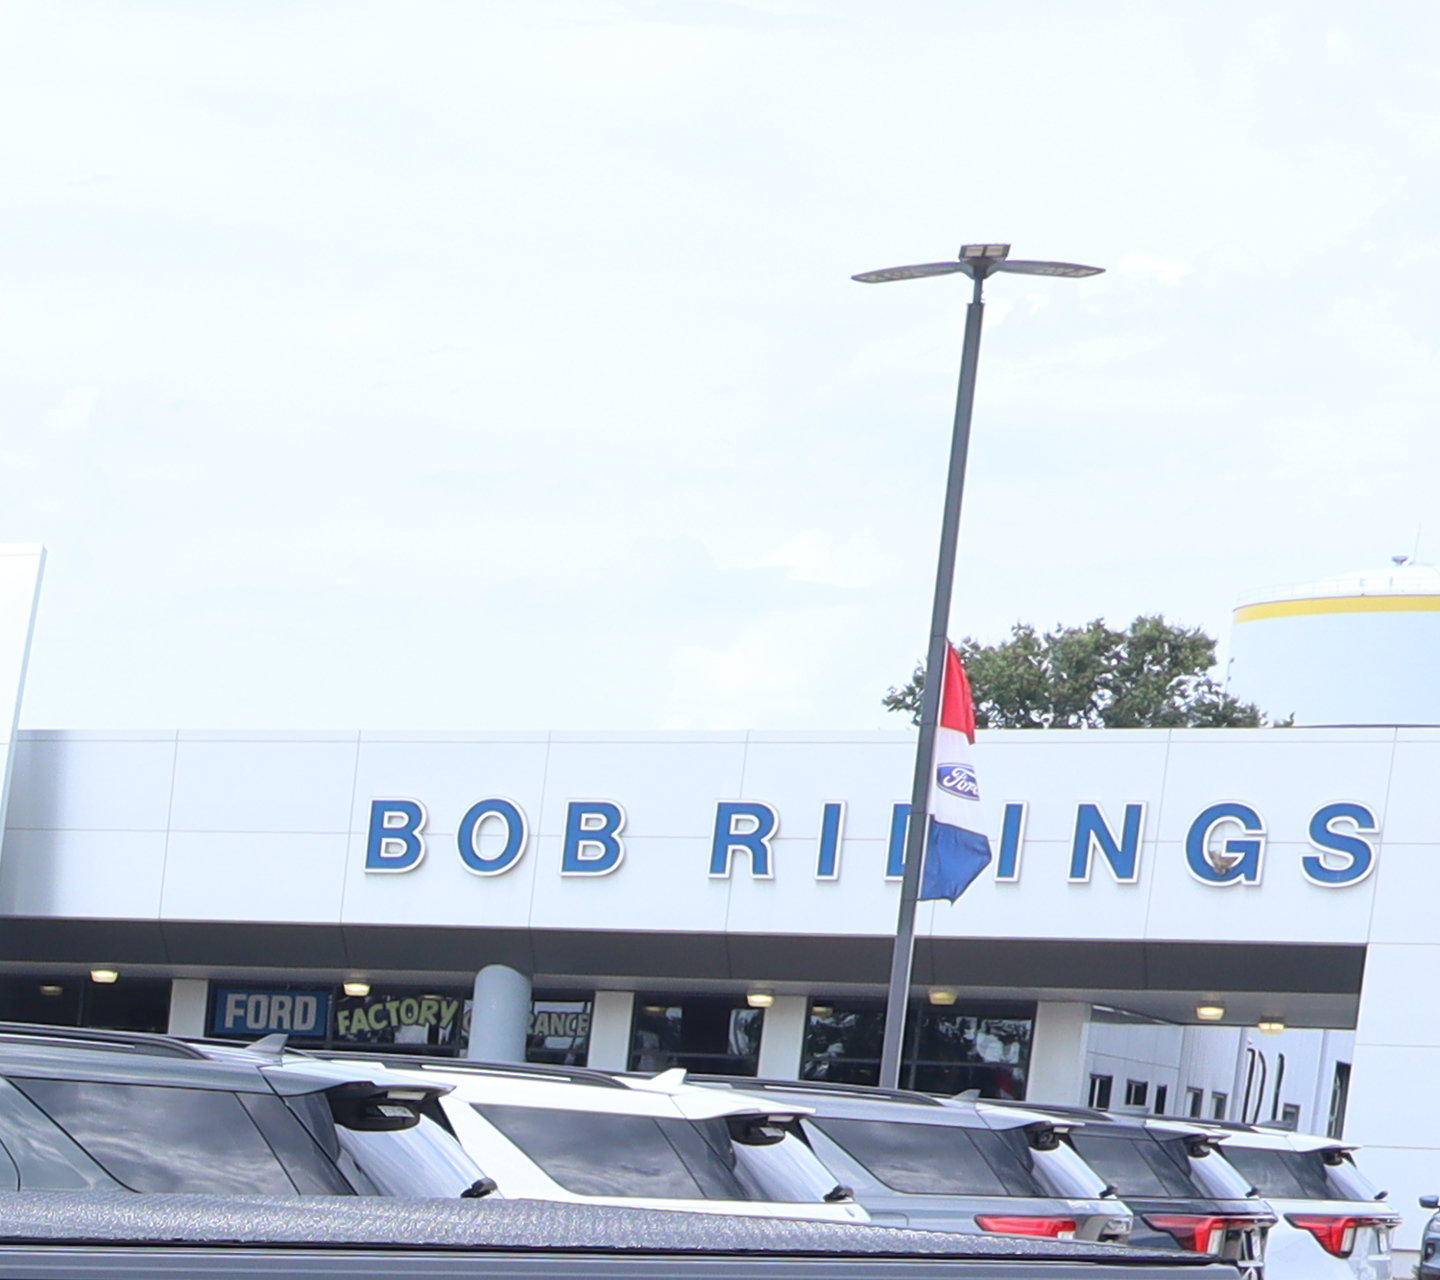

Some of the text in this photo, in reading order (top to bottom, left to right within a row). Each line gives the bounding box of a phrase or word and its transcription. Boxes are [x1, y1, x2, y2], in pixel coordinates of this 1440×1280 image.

[363, 797, 628, 878] BOB
[225, 993, 317, 1031] FORD
[337, 998, 460, 1036] FACTORY
